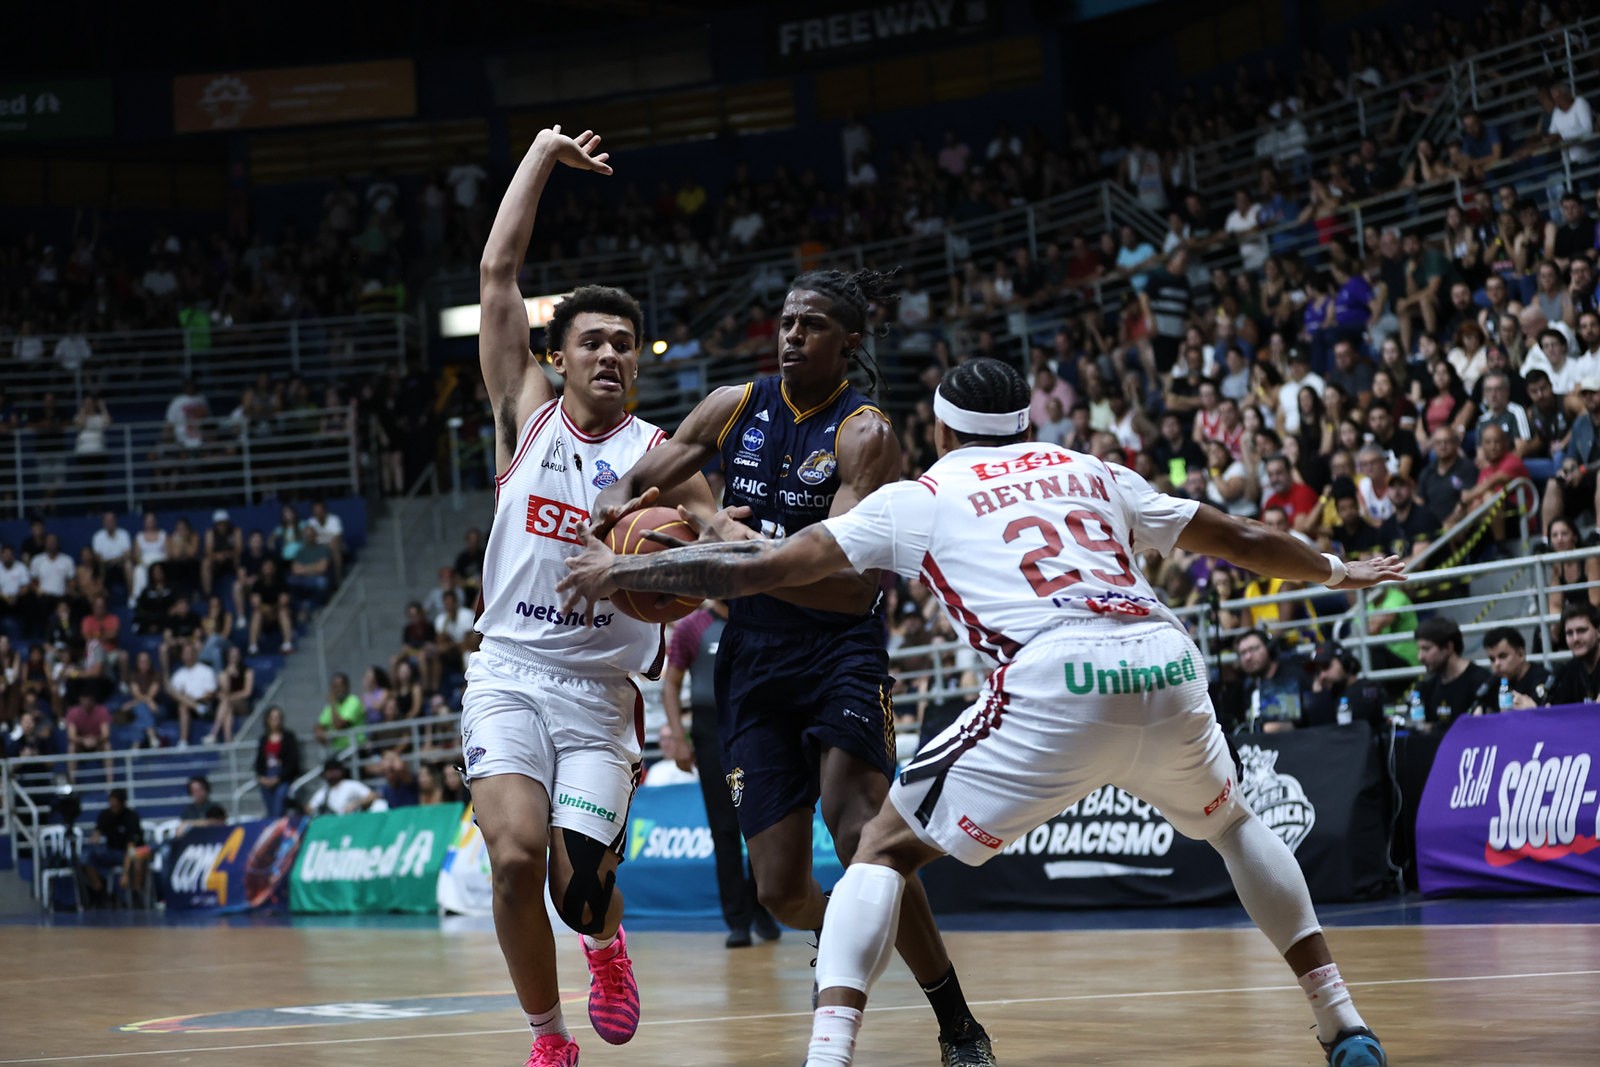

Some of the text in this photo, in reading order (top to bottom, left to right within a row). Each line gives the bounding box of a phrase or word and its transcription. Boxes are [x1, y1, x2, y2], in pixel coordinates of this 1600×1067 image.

[778, 0, 955, 56] FREEWAY
[983, 451, 1062, 477] SESI
[968, 473, 1111, 518] REYNAN
[533, 503, 592, 540] SE
[1002, 509, 1137, 598] 29
[1064, 650, 1197, 695] Unimed
[558, 793, 617, 823] Unimed
[1081, 784, 1161, 821] BASQ
[1450, 742, 1600, 851] SEJA SÓCIO-
[961, 819, 999, 848] FIESP
[1028, 823, 1049, 855] O
[1049, 821, 1174, 856] RACISMO
[301, 831, 407, 883] Unimed
